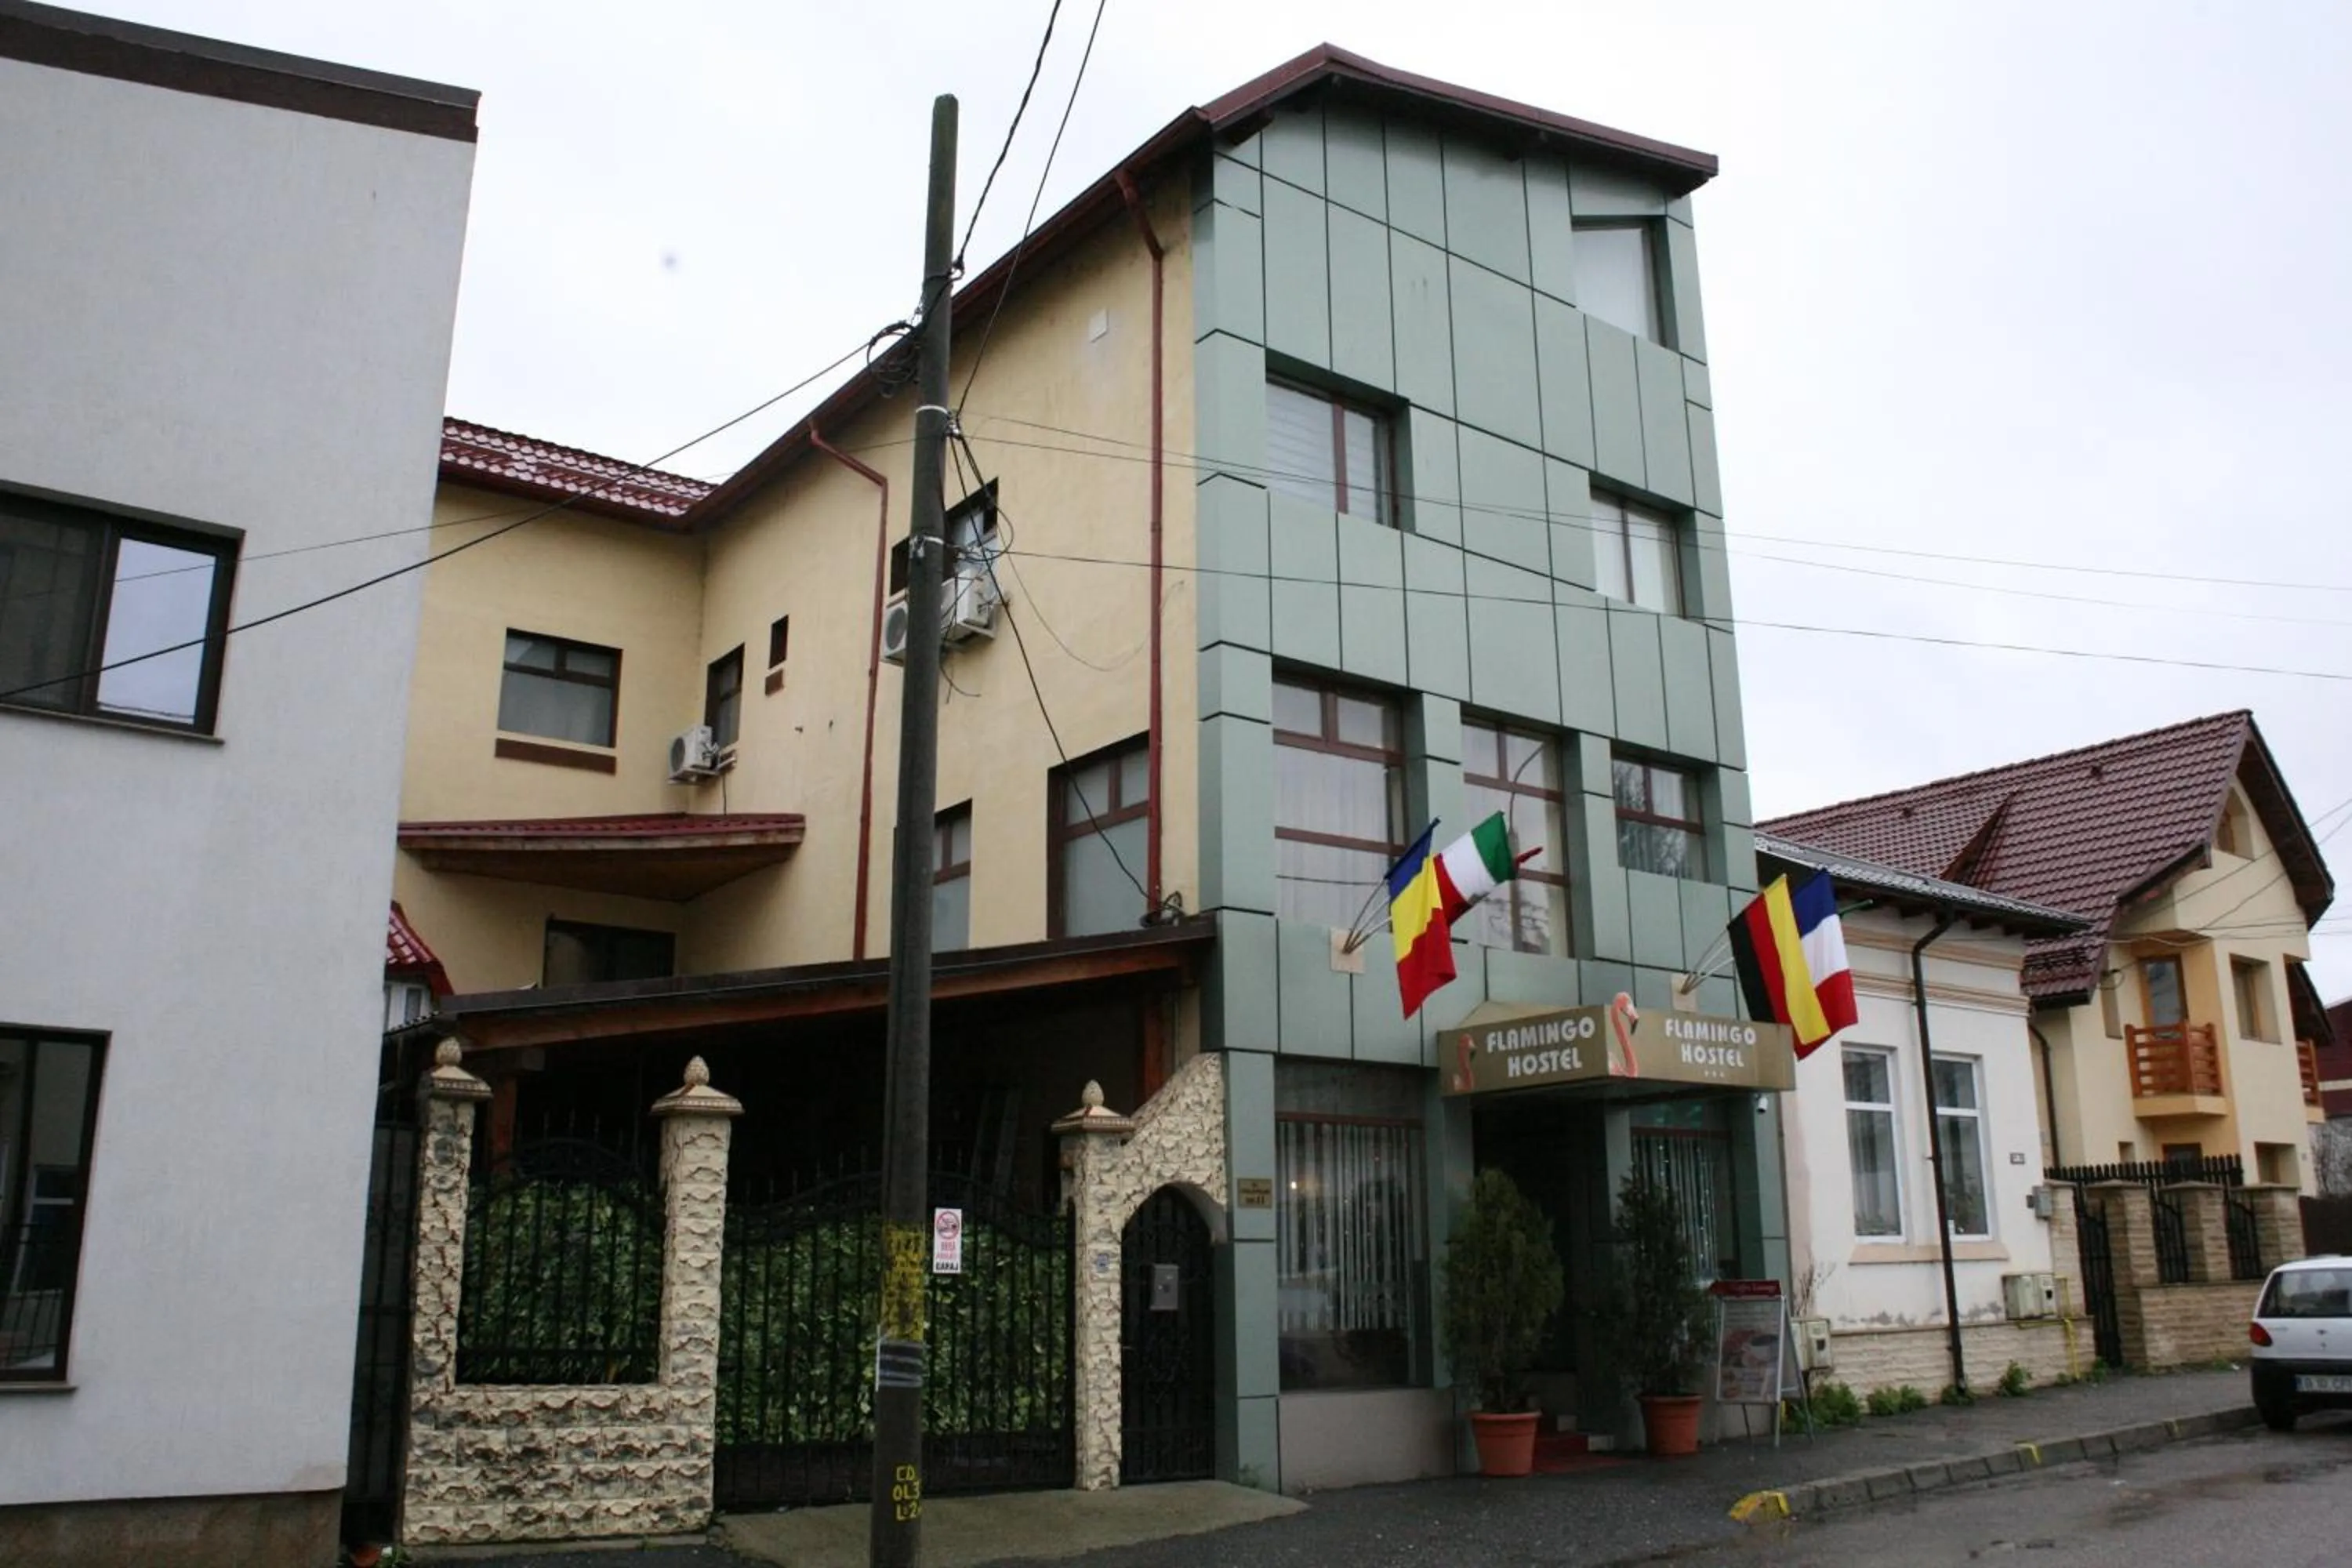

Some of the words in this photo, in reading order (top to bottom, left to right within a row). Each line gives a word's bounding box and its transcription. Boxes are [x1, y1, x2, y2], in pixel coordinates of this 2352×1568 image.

[1486, 1015, 1596, 1053] FLAMINGO
[1664, 1017, 1757, 1046] FLAMINGO
[1507, 1046, 1583, 1078] HOSTEL
[1680, 1043, 1745, 1069] HOSTEL
